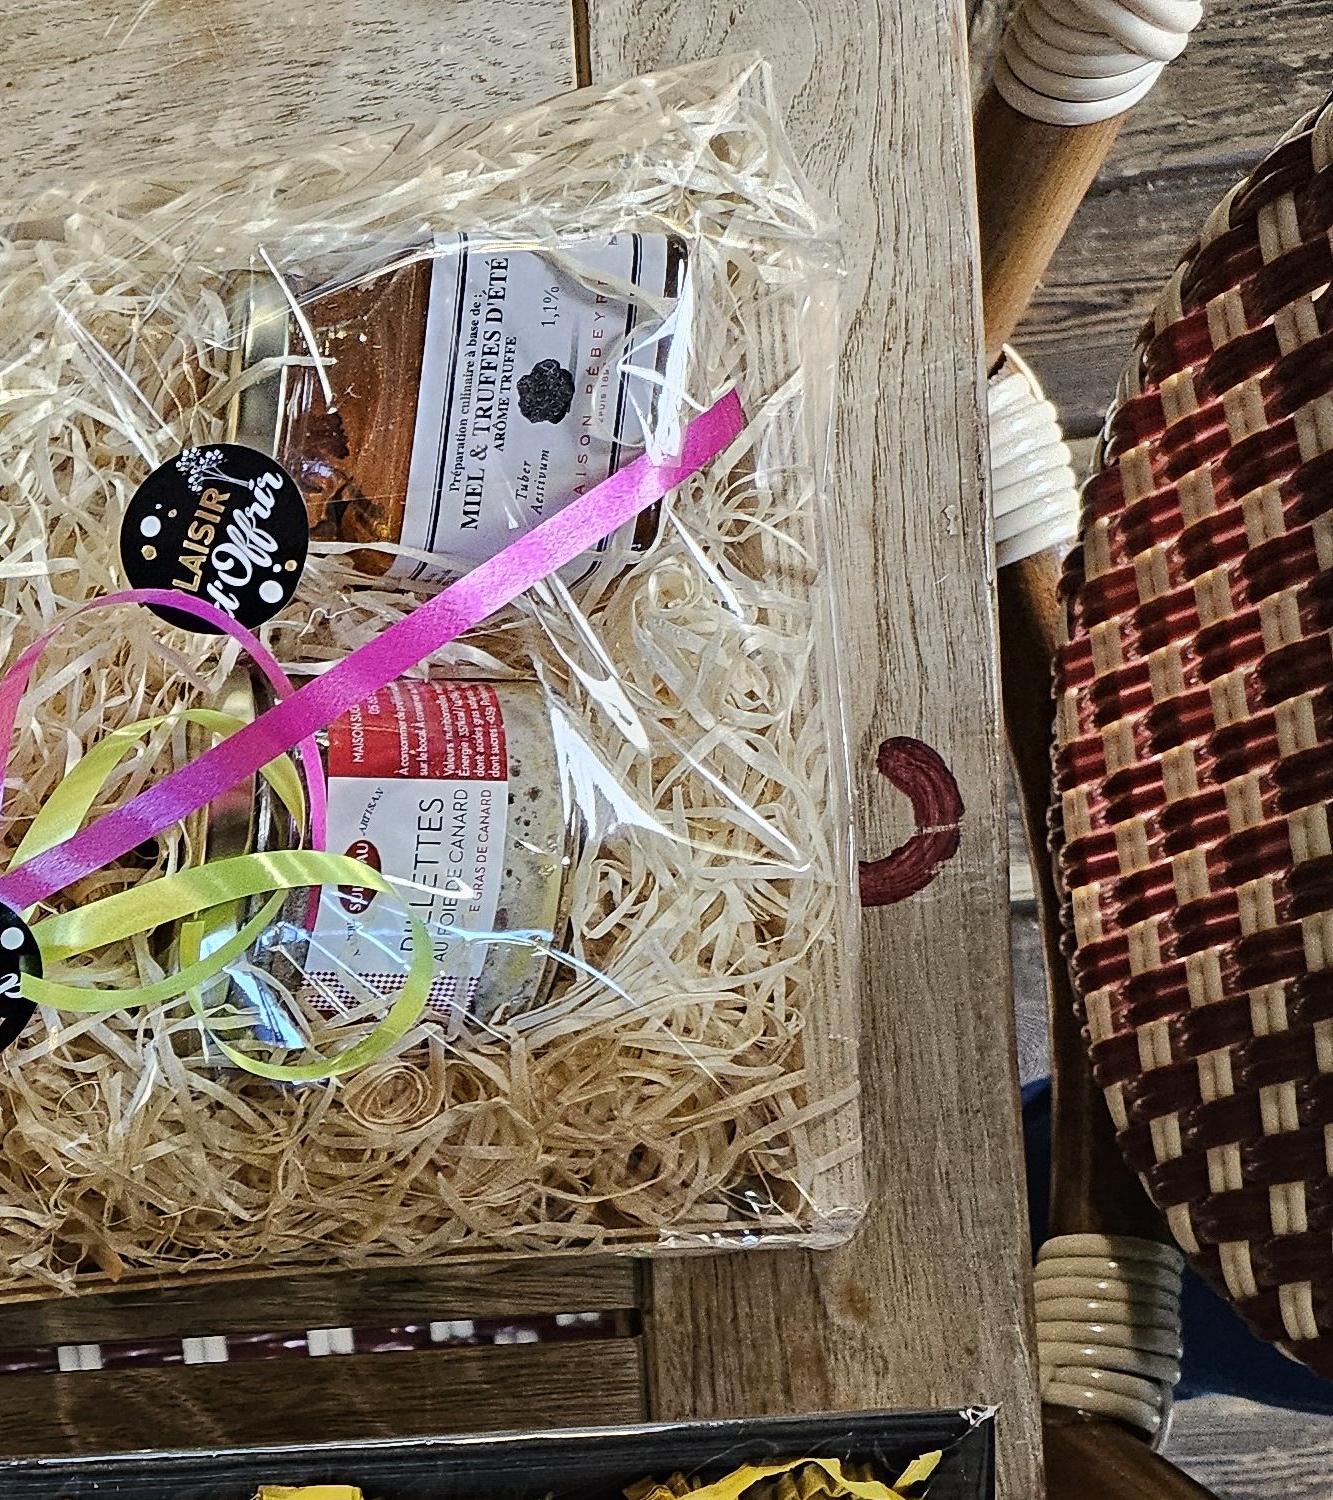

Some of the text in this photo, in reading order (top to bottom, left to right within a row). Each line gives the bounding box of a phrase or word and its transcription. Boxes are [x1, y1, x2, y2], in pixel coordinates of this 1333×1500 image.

[468, 301, 481, 315] de
[541, 286, 560, 327] 1,1%
[465, 320, 478, 347] base
[459, 361, 475, 414] culinaire
[460, 257, 509, 530] MIEL & TRUFFES D'ÉTÉ
[492, 336, 517, 452] ARÔME TRUFFE
[448, 418, 468, 491] Préparation
[573, 415, 593, 495] AISON
[515, 460, 532, 500] Tuber
[531, 449, 550, 515] Aestivum
[172, 488, 231, 592] LAISIR
[206, 472, 283, 619] d'Offrir
[351, 722, 364, 762] MAISON
[444, 743, 455, 776] Valeurs
[454, 742, 472, 777] Énergie
[475, 754, 486, 777] dont
[490, 754, 501, 777] dont
[358, 787, 384, 836] ARTISAN
[478, 790, 491, 842] CANARD
[433, 789, 468, 962] AU DE CANARD
[476, 847, 487, 863] DE
[472, 867, 486, 900] GRAS
